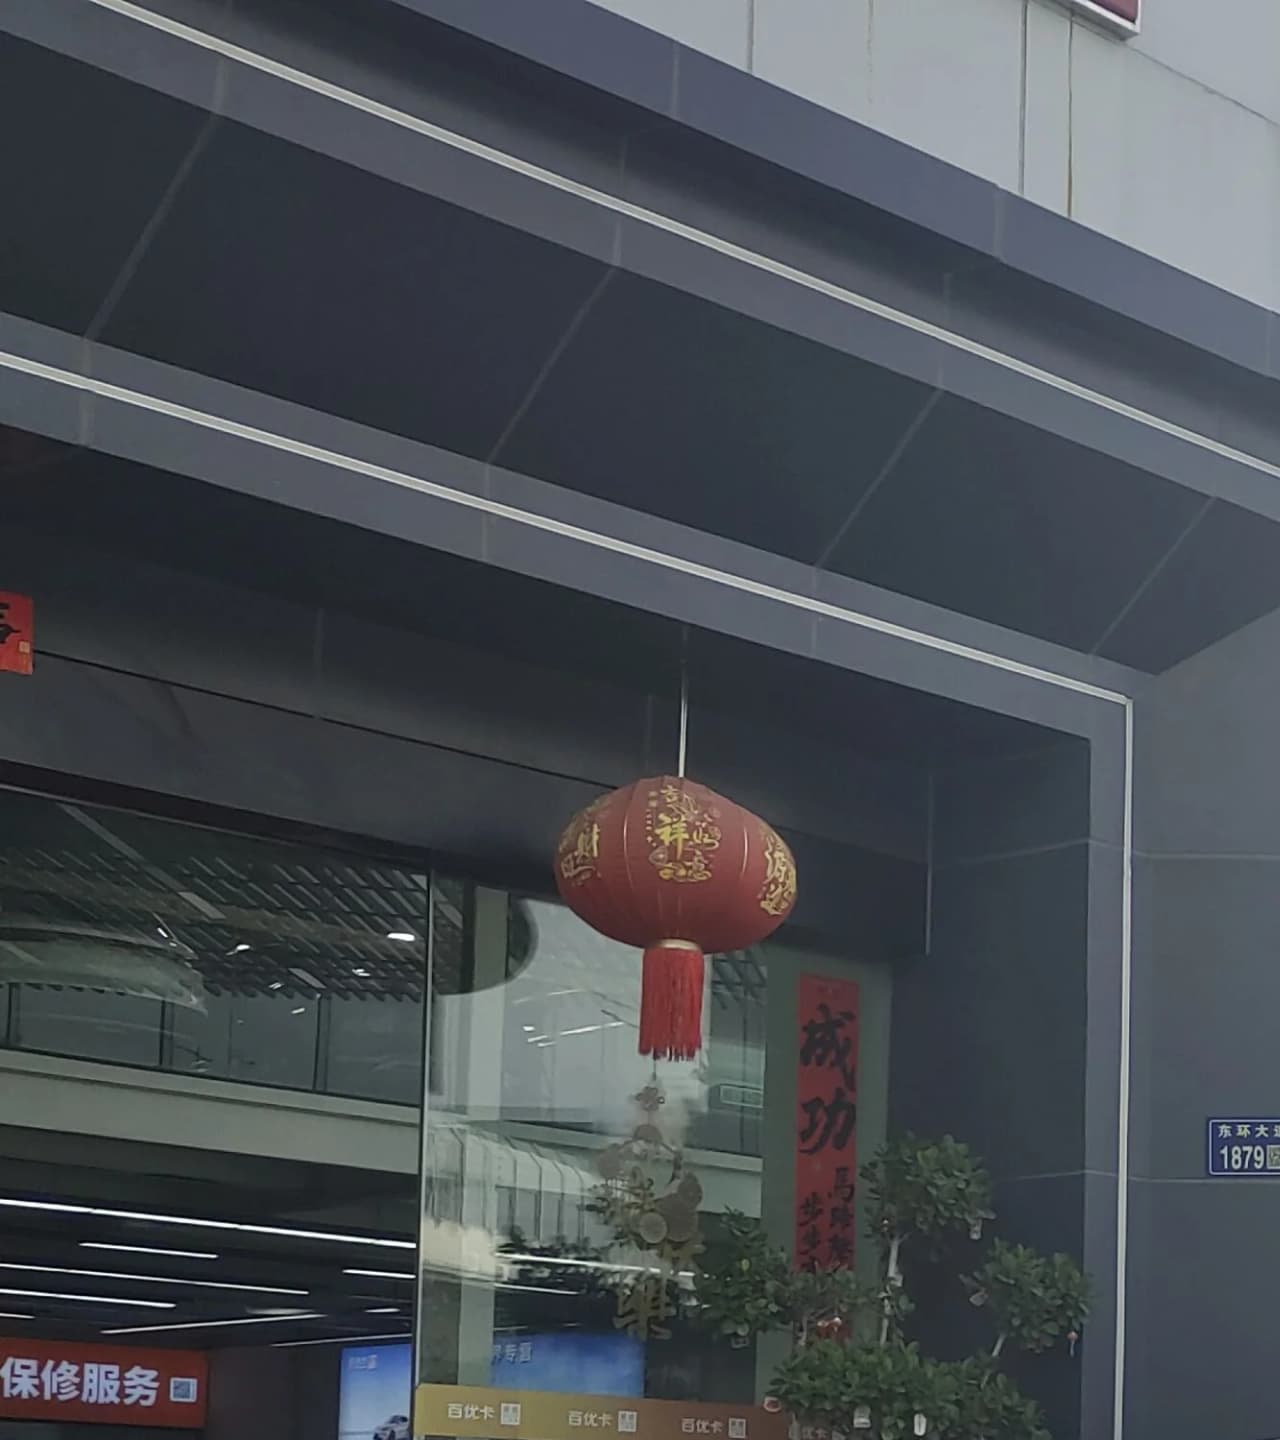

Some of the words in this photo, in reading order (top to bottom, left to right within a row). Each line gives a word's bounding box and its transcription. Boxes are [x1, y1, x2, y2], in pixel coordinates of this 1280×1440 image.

[799, 1003, 856, 1155] 成功
[1220, 1145, 1264, 1169] 1879
[0, 1356, 160, 1406] 保修服务
[447, 1403, 495, 1420] 百优卡
[568, 1411, 613, 1427] 百优卡
[681, 1418, 723, 1434] 百优卡
